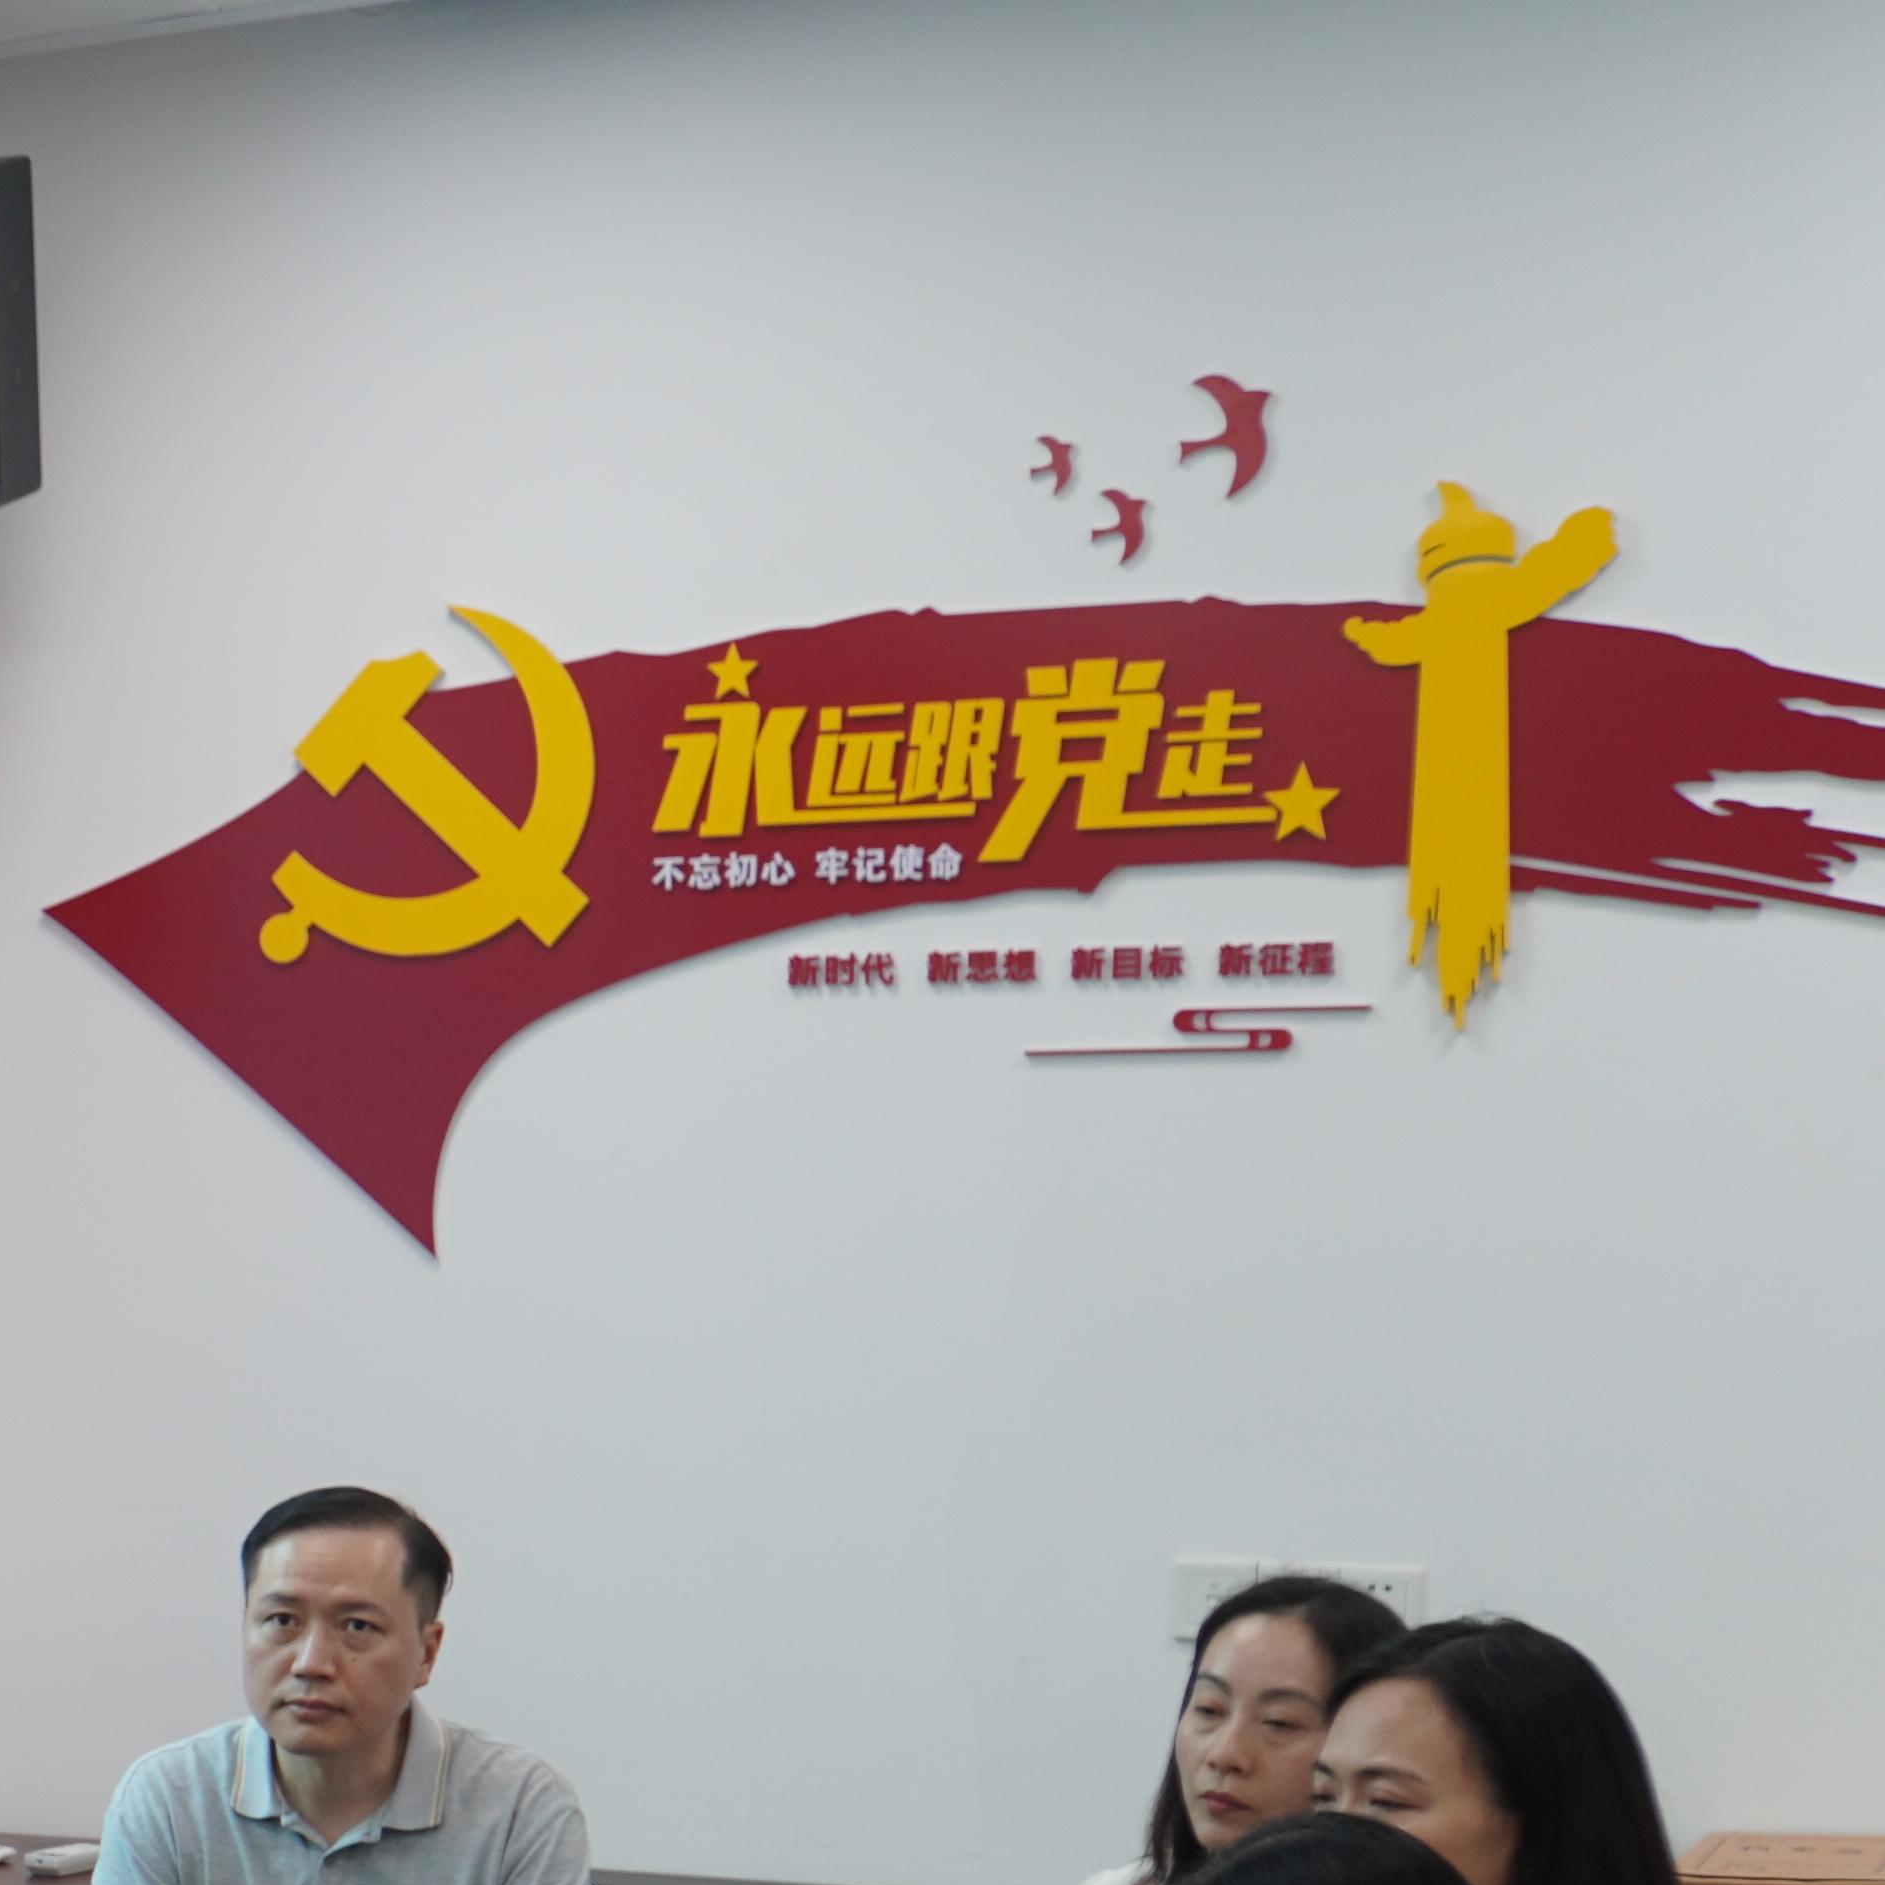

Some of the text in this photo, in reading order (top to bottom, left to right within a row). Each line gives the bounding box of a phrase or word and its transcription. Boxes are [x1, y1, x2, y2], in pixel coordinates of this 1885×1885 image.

[651, 657, 1278, 862] 永远跟党走
[652, 842, 963, 891] 不忘初心 牢记使命
[788, 942, 1335, 988] 新时代 新思想 新目标 新征程
